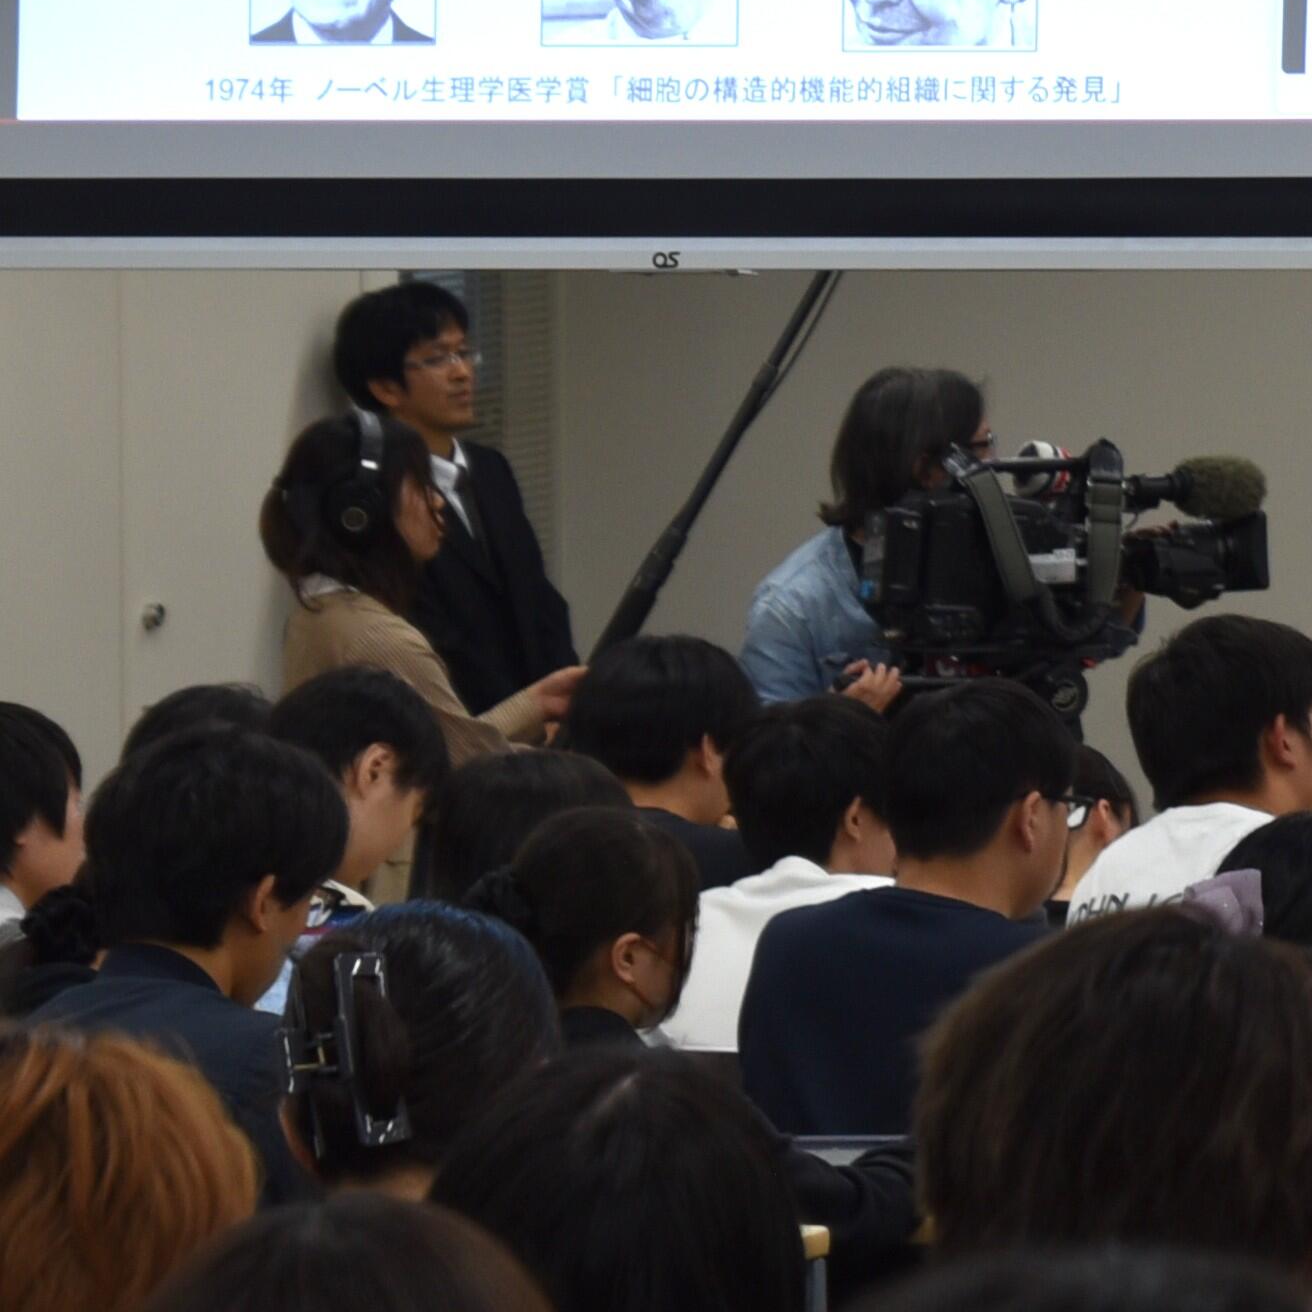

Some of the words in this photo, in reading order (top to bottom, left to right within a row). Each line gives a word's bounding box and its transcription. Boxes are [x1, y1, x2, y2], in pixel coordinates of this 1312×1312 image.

[205, 76, 293, 104] 1974年
[316, 75, 589, 104] ノーベル生理学医学賞
